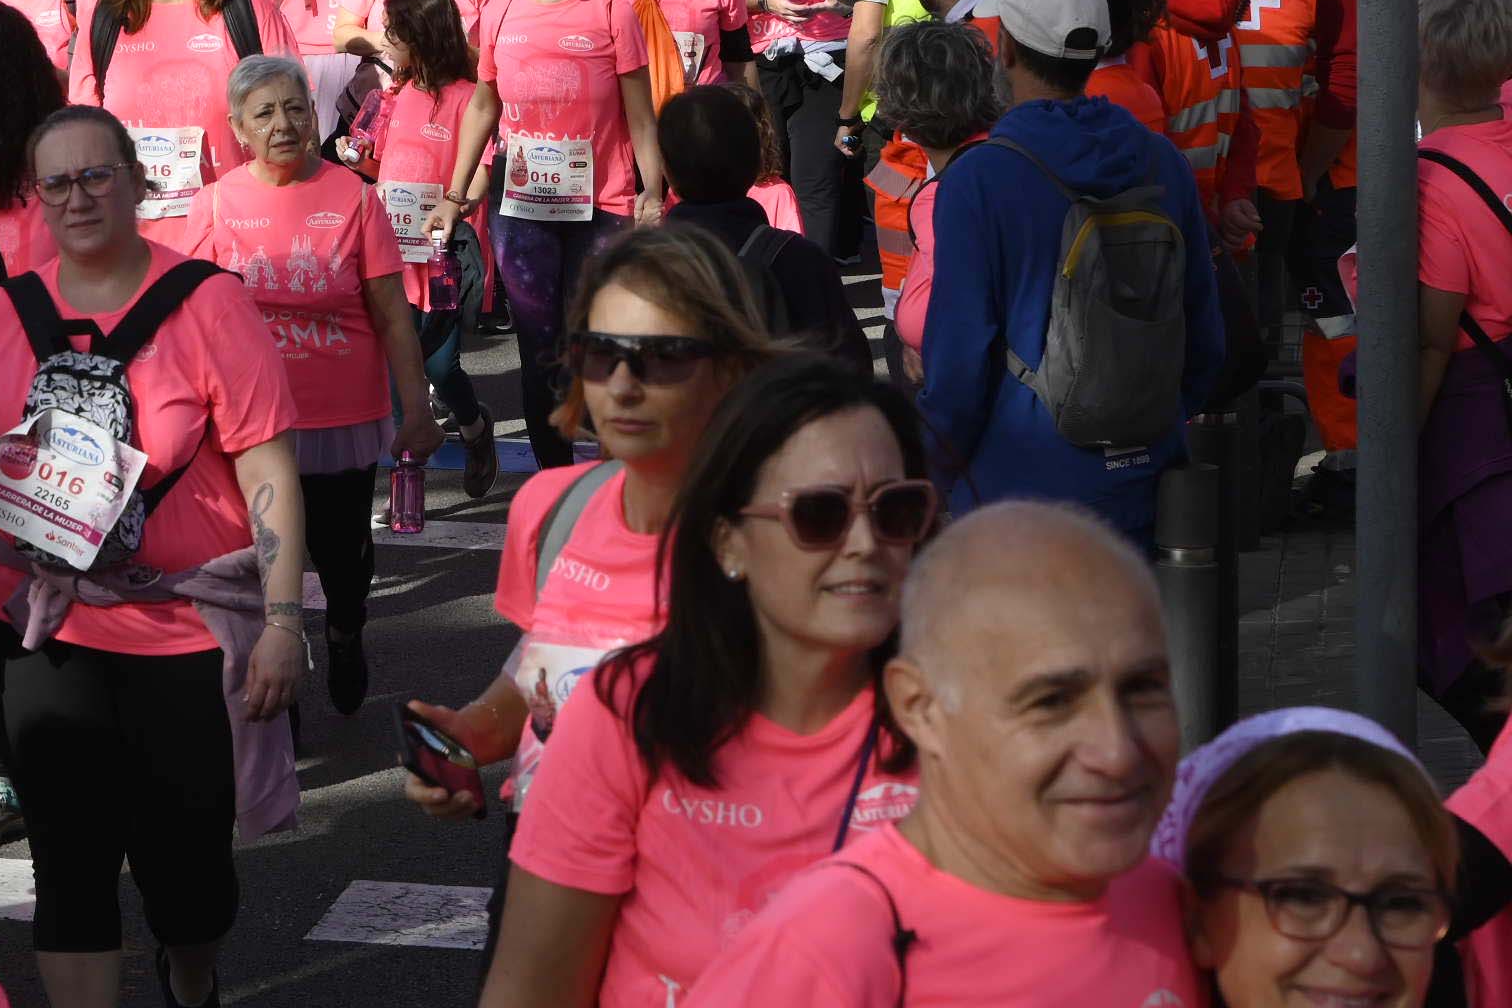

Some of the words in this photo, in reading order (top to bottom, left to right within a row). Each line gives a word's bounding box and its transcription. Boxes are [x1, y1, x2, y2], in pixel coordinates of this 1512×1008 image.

[530, 171, 561, 184] 016
[534, 186, 557, 194] 13023
[225, 217, 271, 230] OYSHO
[38, 461, 86, 496] 016
[35, 486, 71, 511] 22165
[32, 503, 43, 514] DE
[43, 508, 55, 520] LA
[55, 513, 83, 532] MUJER
[662, 790, 763, 828] OYSHO
